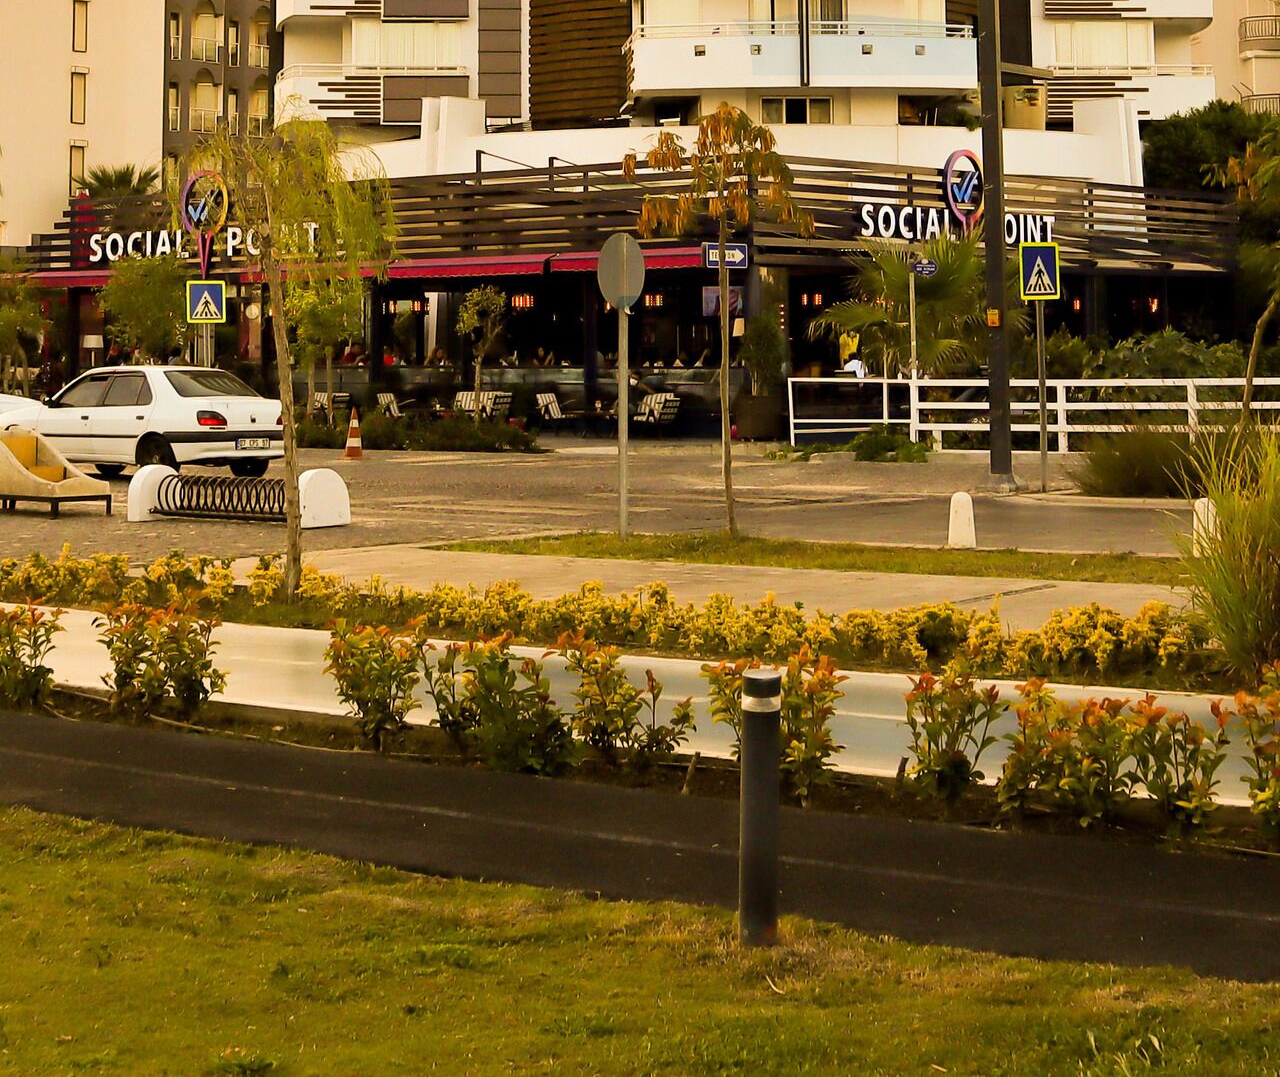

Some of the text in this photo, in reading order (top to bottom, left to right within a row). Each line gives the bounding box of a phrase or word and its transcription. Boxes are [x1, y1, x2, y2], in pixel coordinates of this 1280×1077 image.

[89, 222, 320, 262] SOCIAL POT
[861, 204, 1056, 245] SOCIAL OINT
